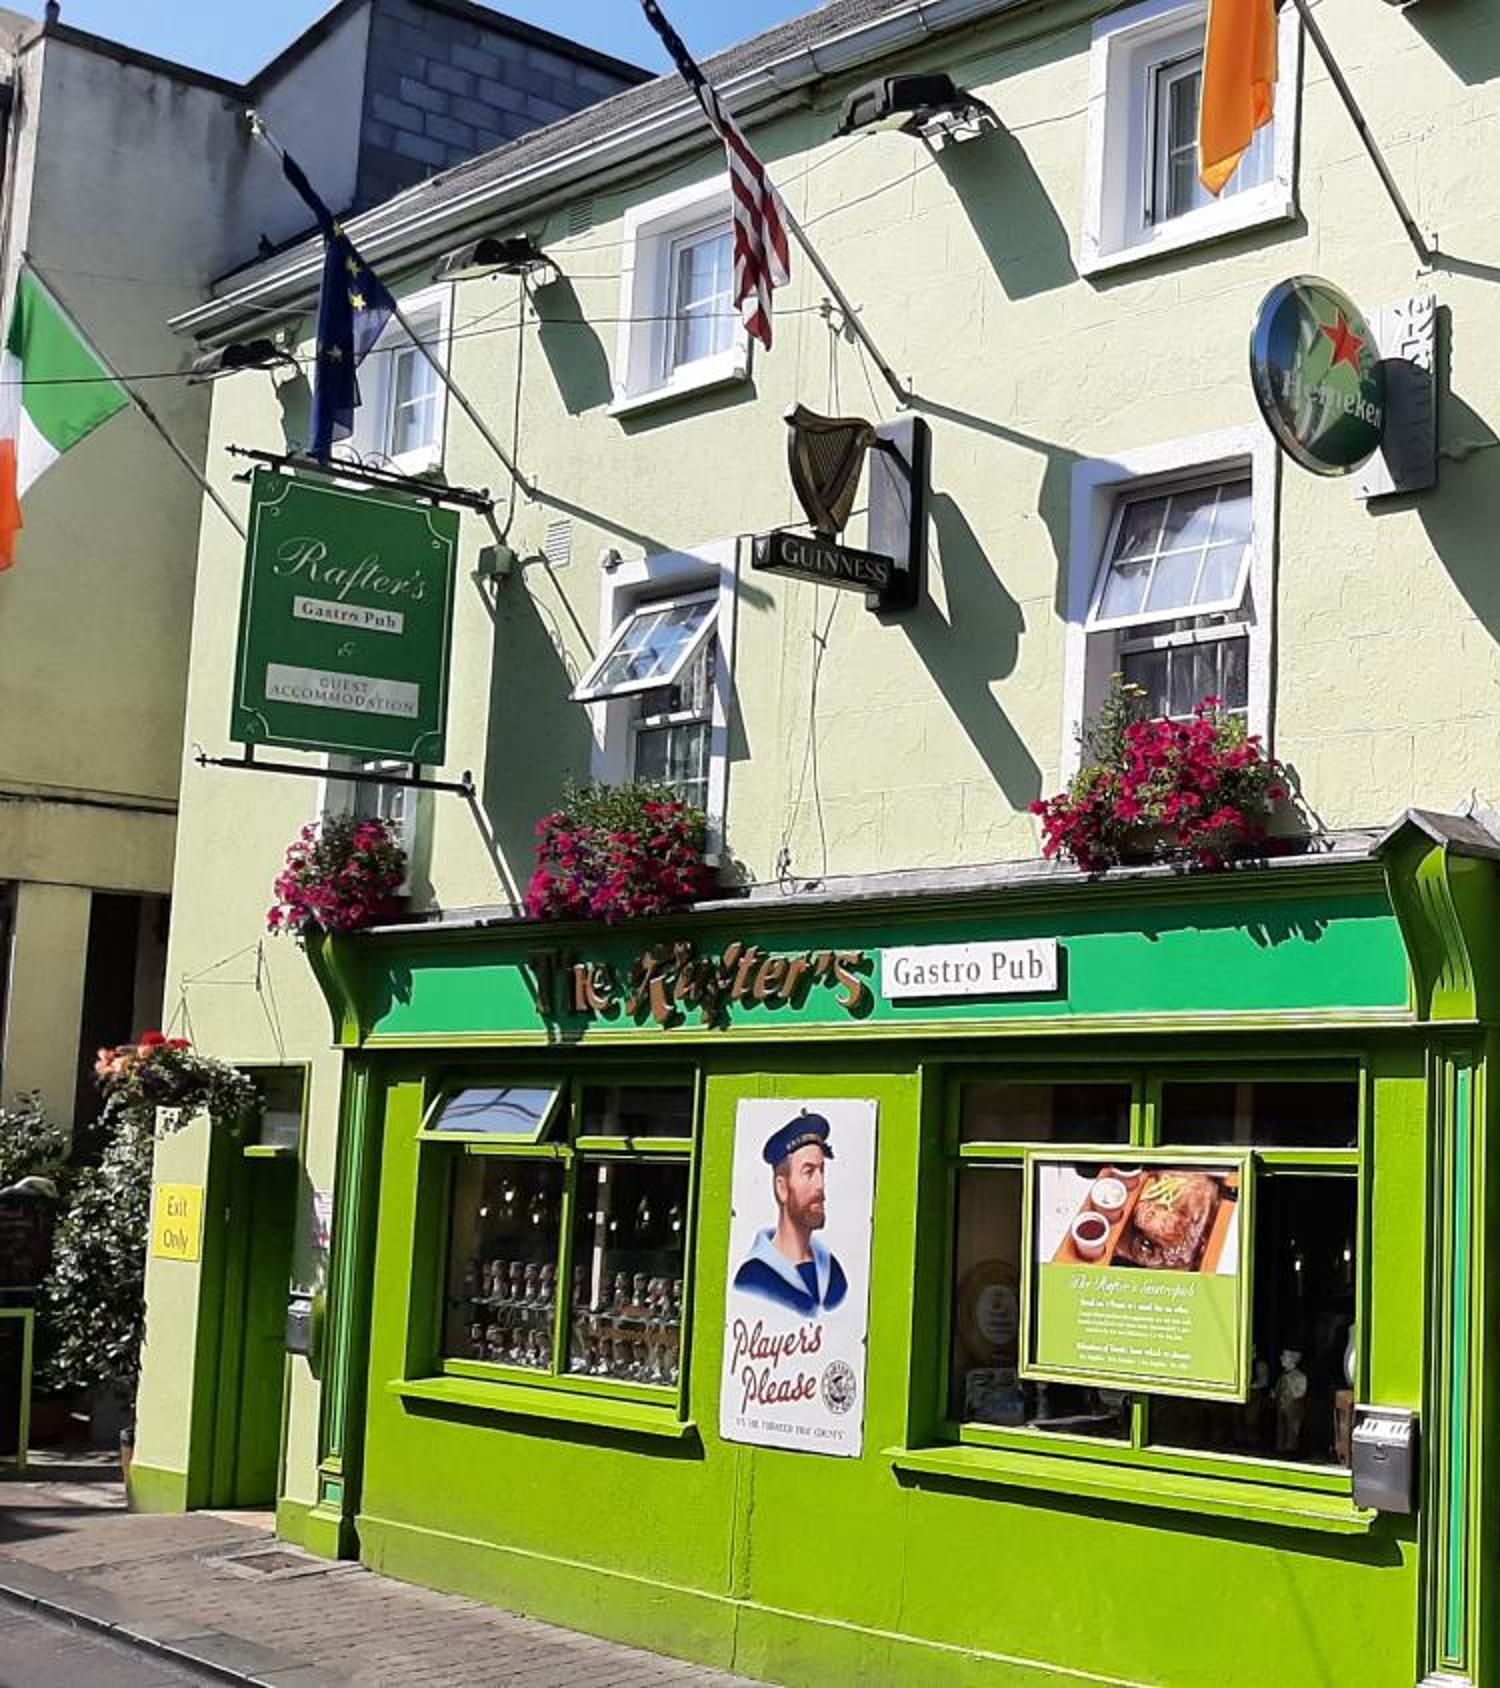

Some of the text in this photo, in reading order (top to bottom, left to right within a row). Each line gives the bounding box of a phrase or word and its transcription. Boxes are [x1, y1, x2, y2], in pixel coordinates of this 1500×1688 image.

[272, 535, 426, 602] Rafter's
[780, 537, 889, 584] GUINNESS
[302, 601, 397, 629] Gastro Pub
[270, 684, 415, 713] ACCOMMODATION
[318, 676, 370, 693] GUEST
[893, 949, 1043, 986] Gastro Pub
[167, 1195, 187, 1217] Exit
[163, 1228, 189, 1255] Only
[731, 1317, 823, 1376] Player's
[741, 1365, 817, 1416] Please
